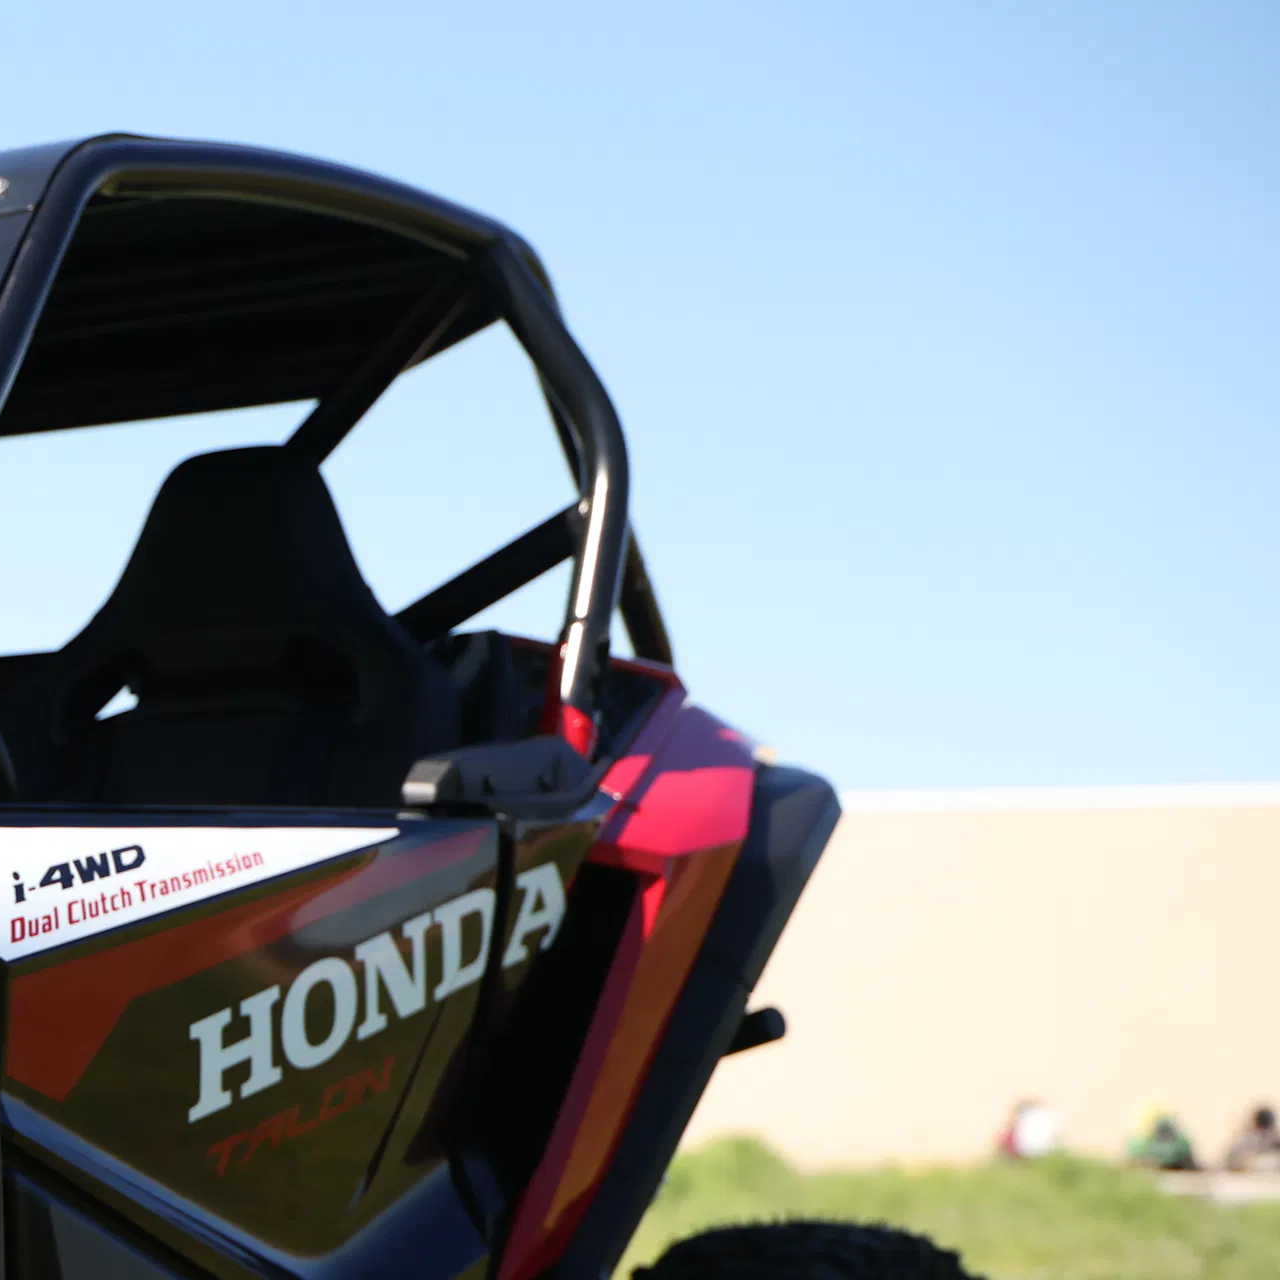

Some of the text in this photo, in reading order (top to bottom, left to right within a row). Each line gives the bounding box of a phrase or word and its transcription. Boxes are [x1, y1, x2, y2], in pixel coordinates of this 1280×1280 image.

[10, 851, 265, 944] Dual Clutch Transmission
[12, 844, 147, 904] i-4WD
[188, 861, 568, 1124] HONDA
[206, 1055, 396, 1177] TALON
